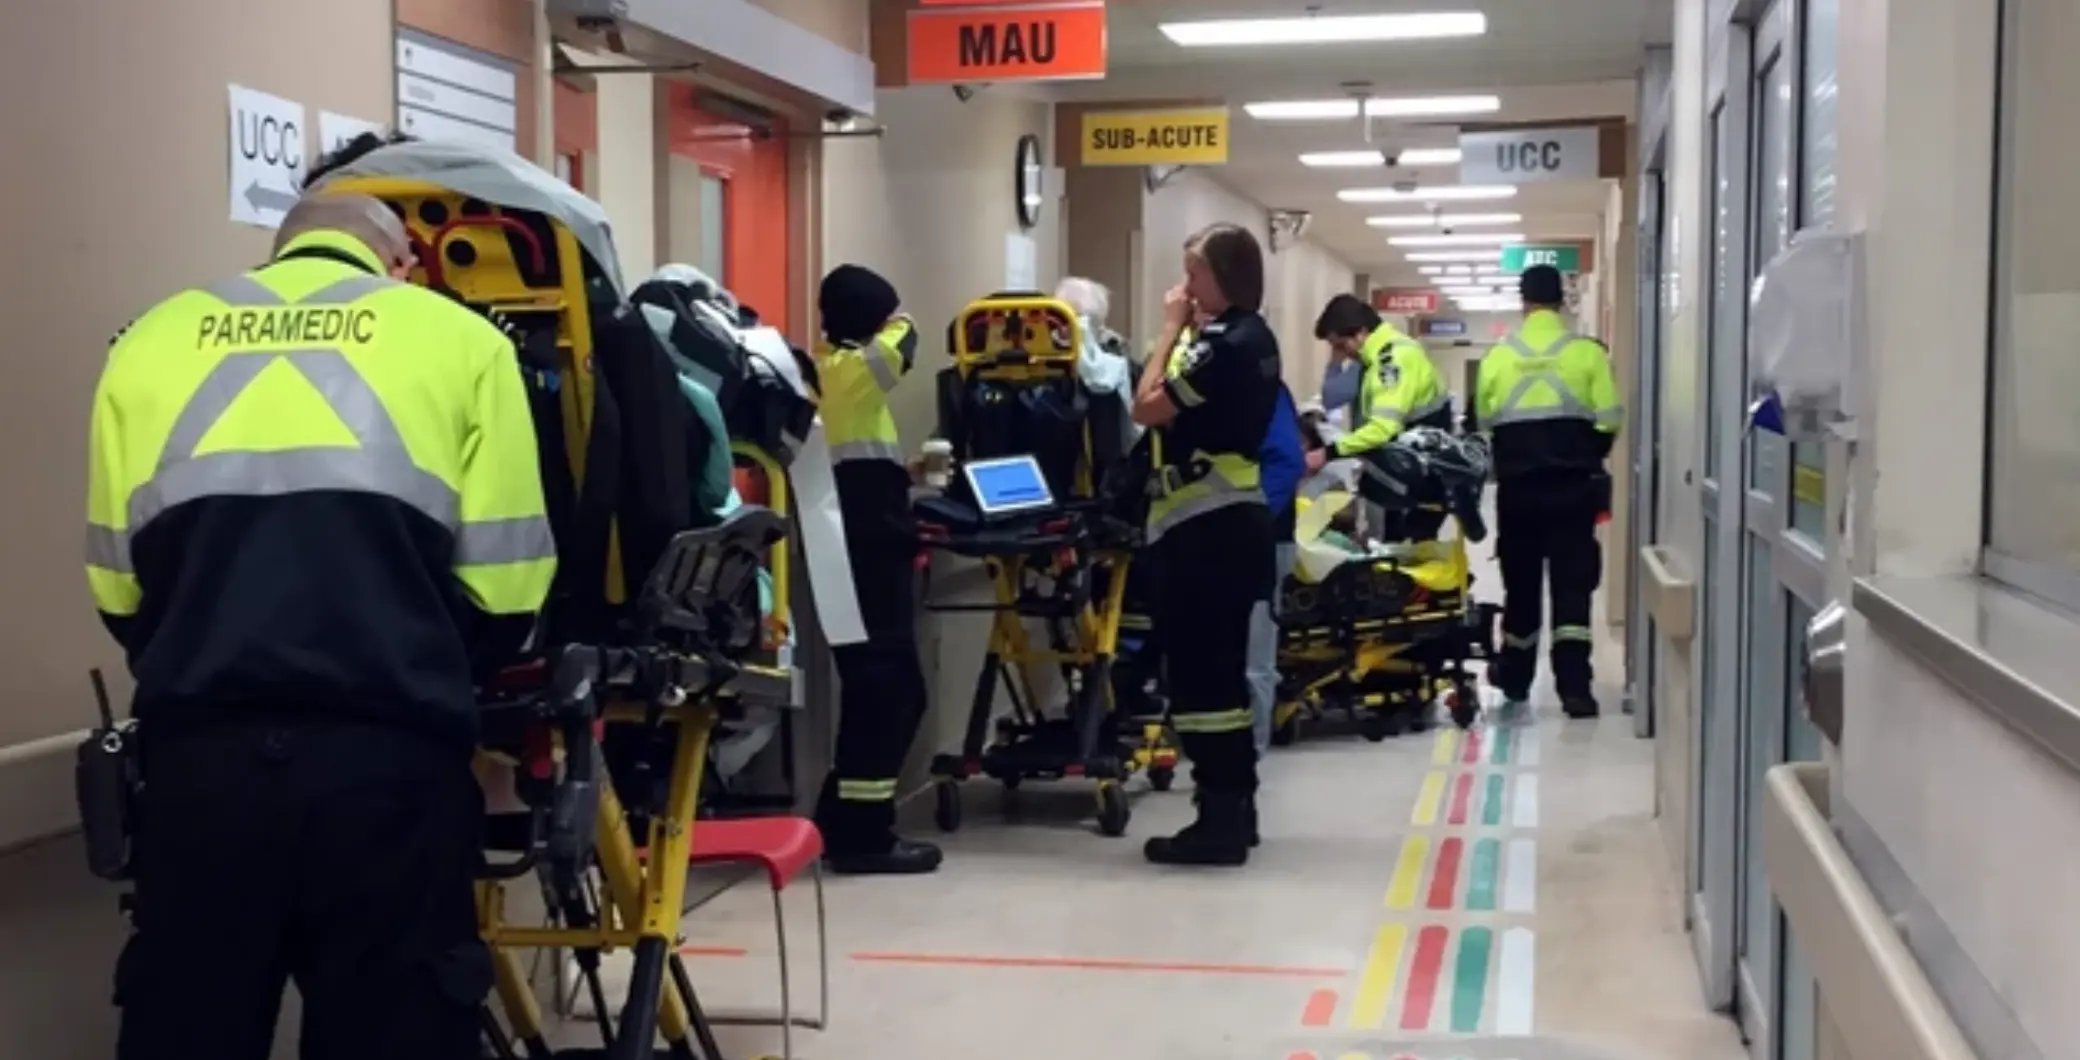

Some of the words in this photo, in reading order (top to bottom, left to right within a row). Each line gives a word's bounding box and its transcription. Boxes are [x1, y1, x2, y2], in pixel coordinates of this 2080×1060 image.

[959, 22, 1056, 66] MAU
[238, 109, 299, 169] UCC
[1092, 124, 1218, 149] SUB-ACUTE
[1497, 140, 1561, 172] UCC
[197, 309, 376, 350] PARAMEDIC
